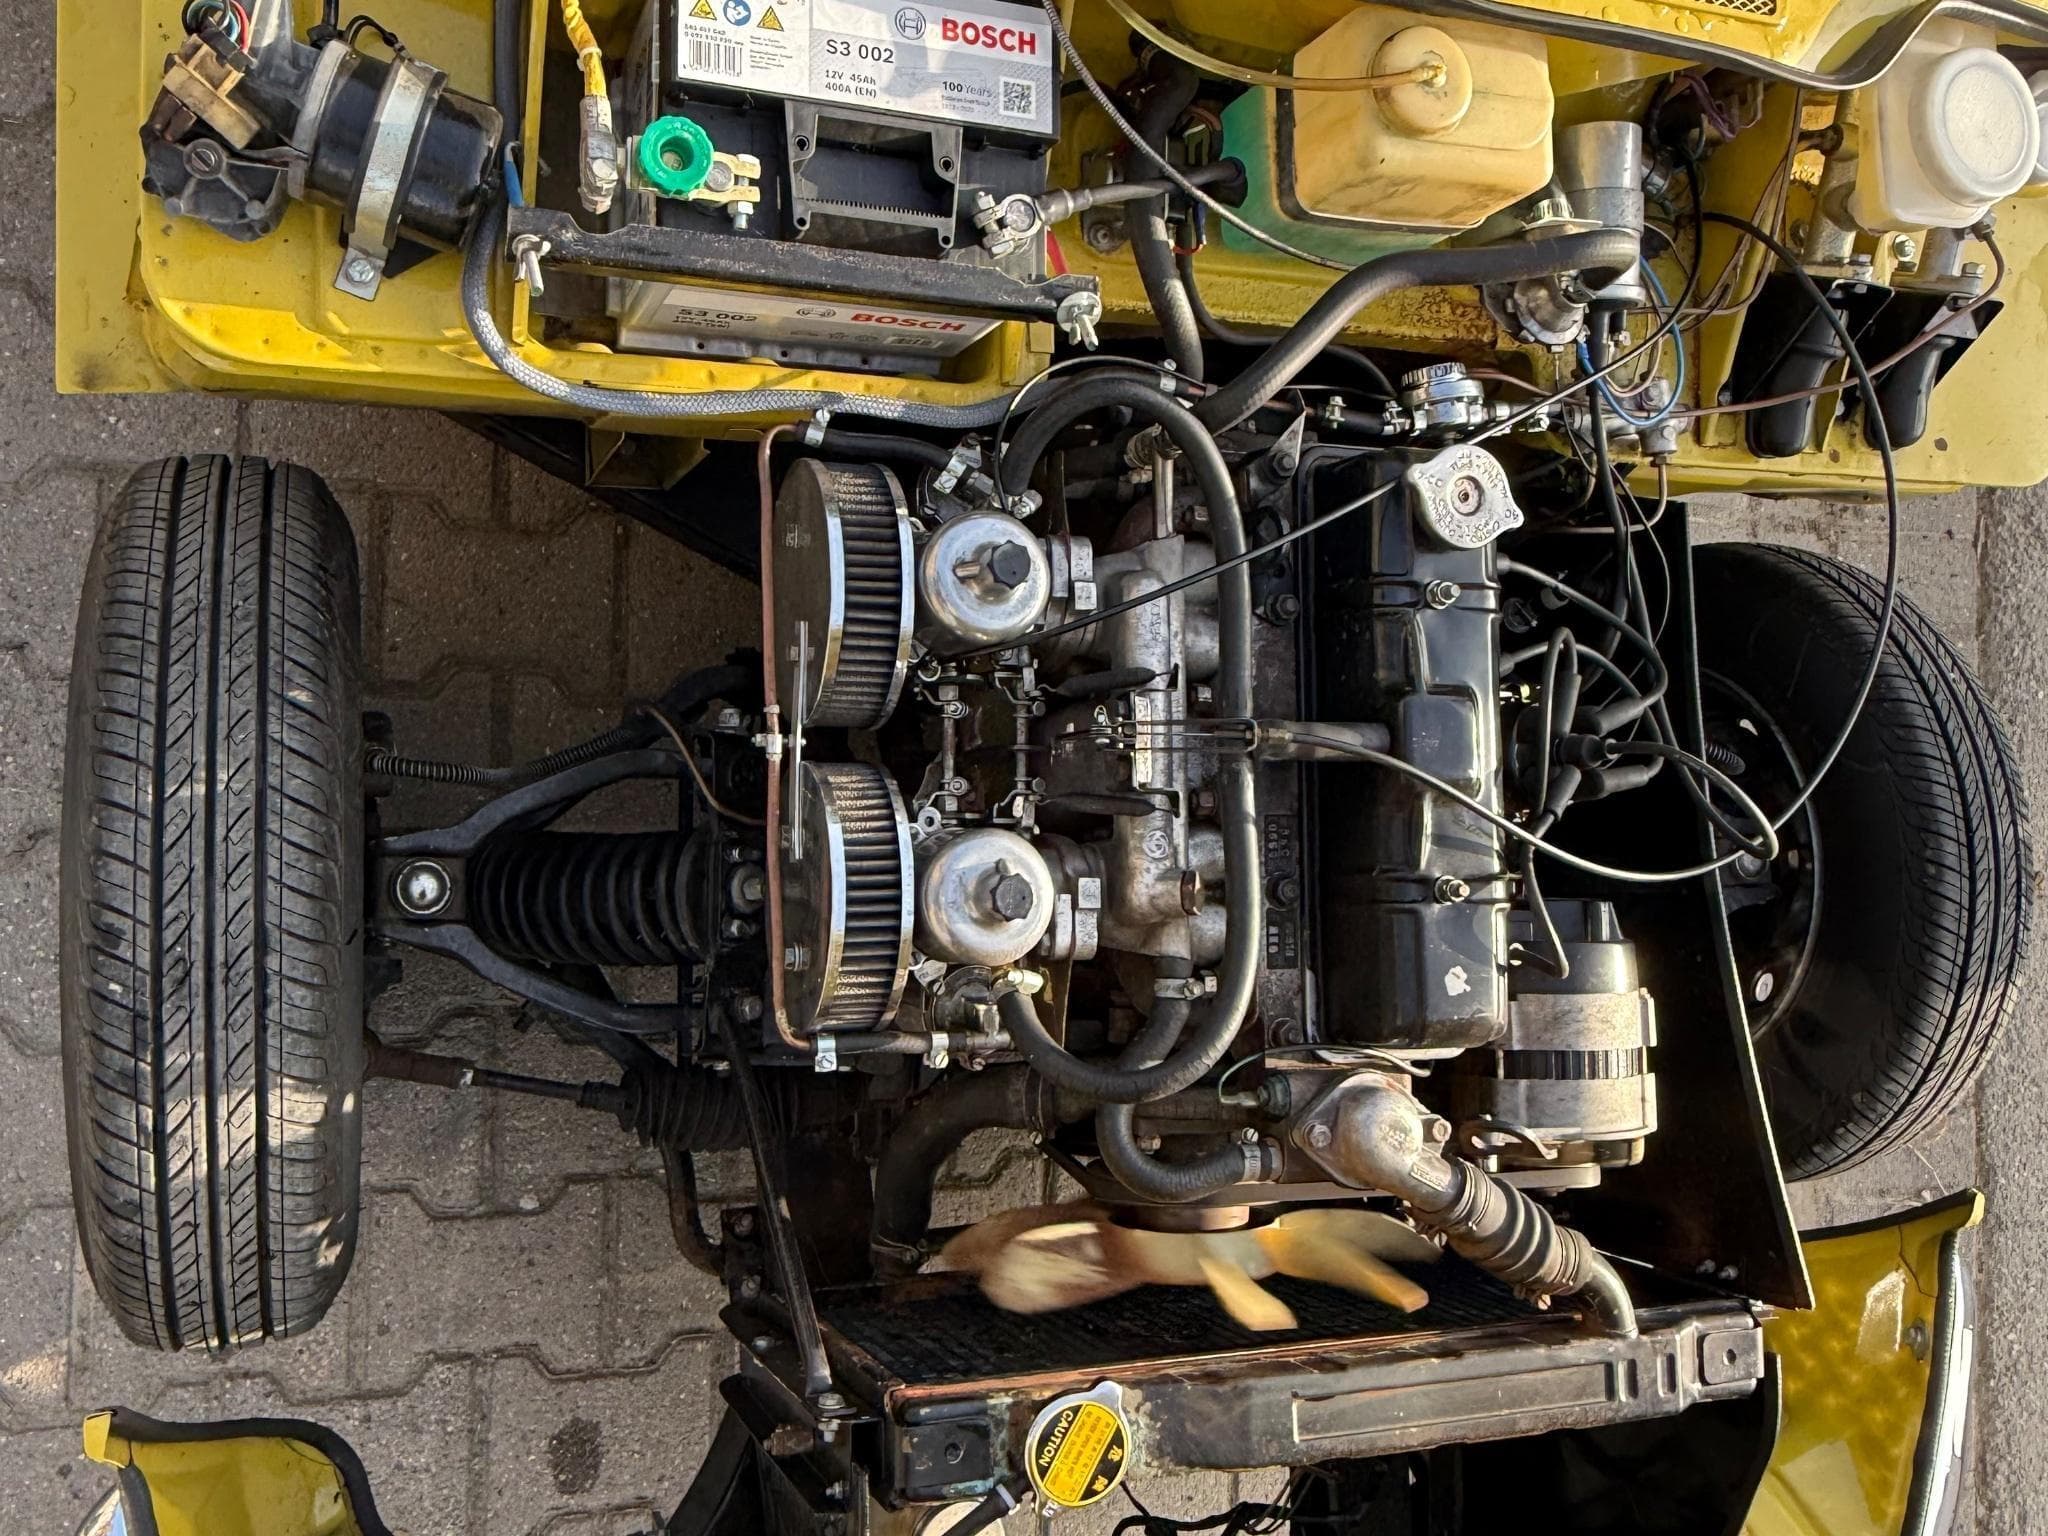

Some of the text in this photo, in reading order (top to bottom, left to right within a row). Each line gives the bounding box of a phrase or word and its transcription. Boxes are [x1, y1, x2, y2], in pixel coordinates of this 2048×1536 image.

[942, 17, 1036, 55] BOSCH
[826, 39, 894, 63] S3 002
[825, 69, 876, 86] 12V 45Ah
[942, 81, 963, 93] 100
[825, 82, 852, 94] 400A
[851, 313, 966, 332] BOSCH
[1038, 1410, 1073, 1467] CAUTION
